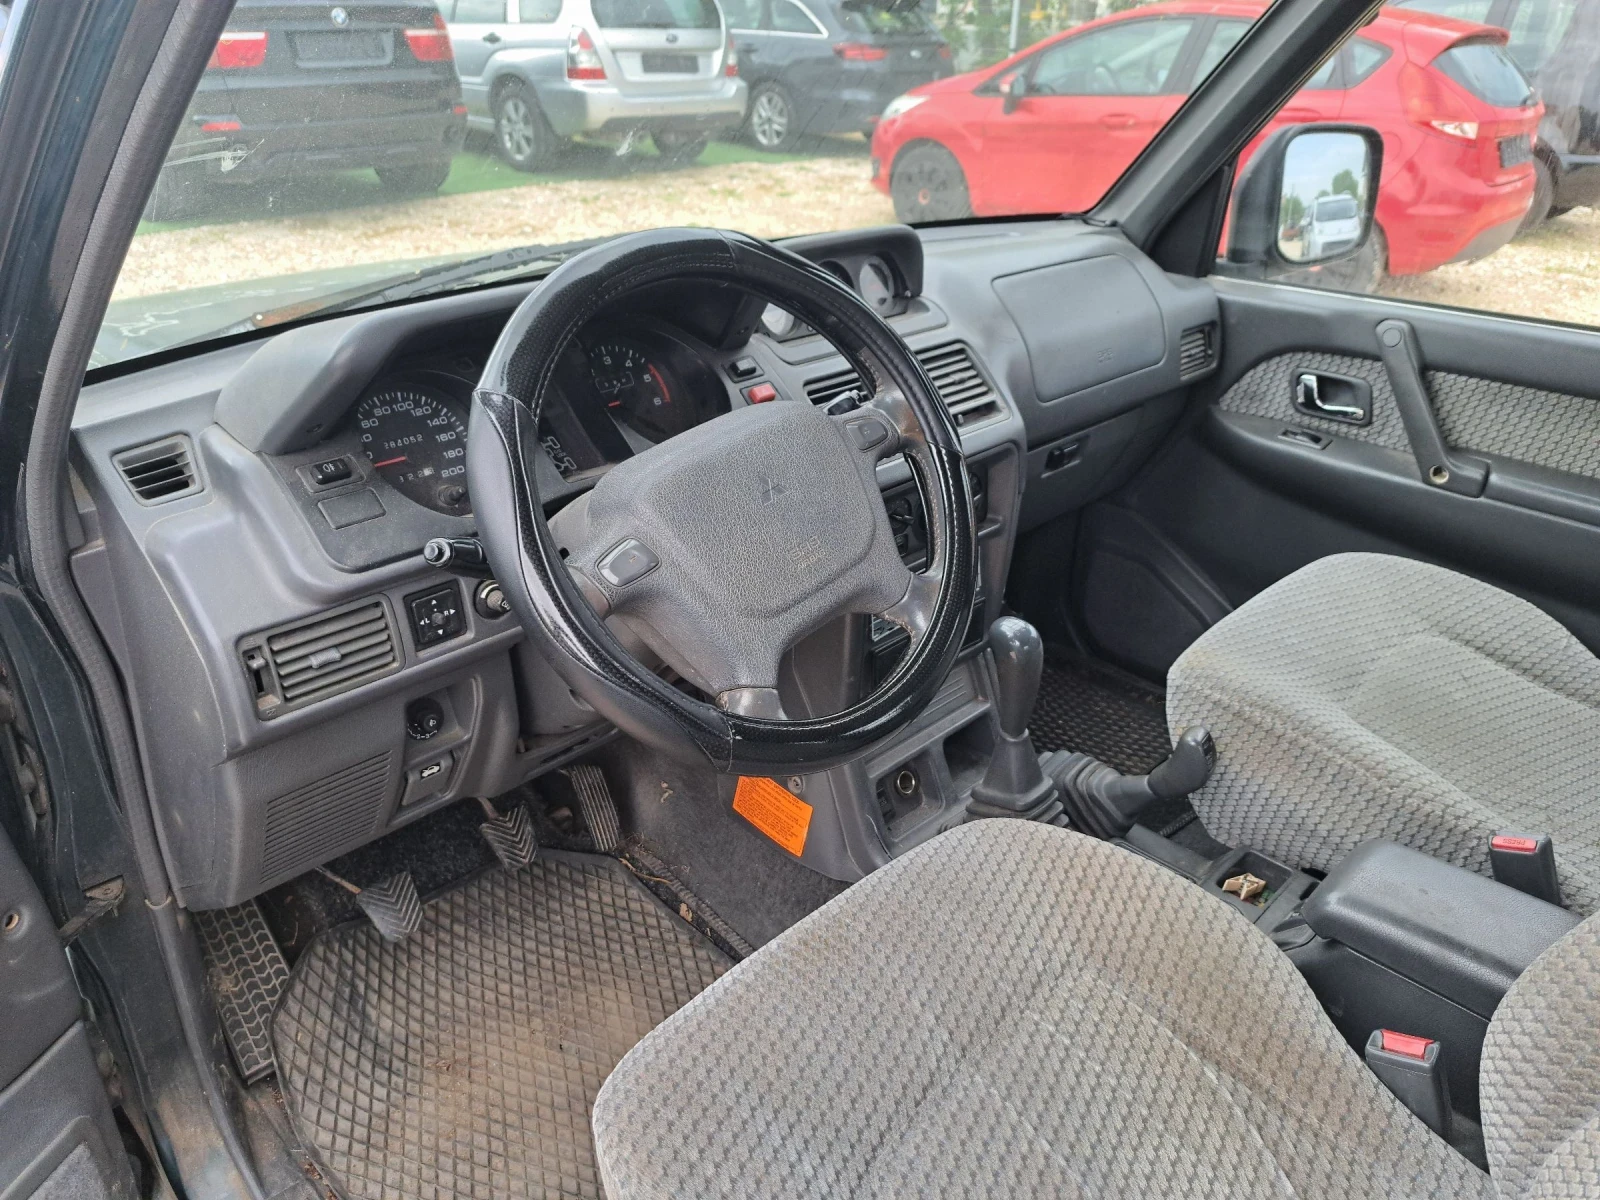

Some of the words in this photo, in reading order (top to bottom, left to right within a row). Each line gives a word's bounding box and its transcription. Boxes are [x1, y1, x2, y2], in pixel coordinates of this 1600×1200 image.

[603, 356, 612, 365] 3
[625, 359, 633, 368] 4
[373, 406, 391, 417] 80
[392, 401, 414, 412] 100
[410, 406, 432, 417] 120
[361, 418, 379, 429] 60
[427, 416, 448, 427] 140
[435, 431, 456, 443] 160
[443, 447, 464, 459] 180
[441, 465, 465, 478] 200
[1502, 838, 1526, 846] PRESS
